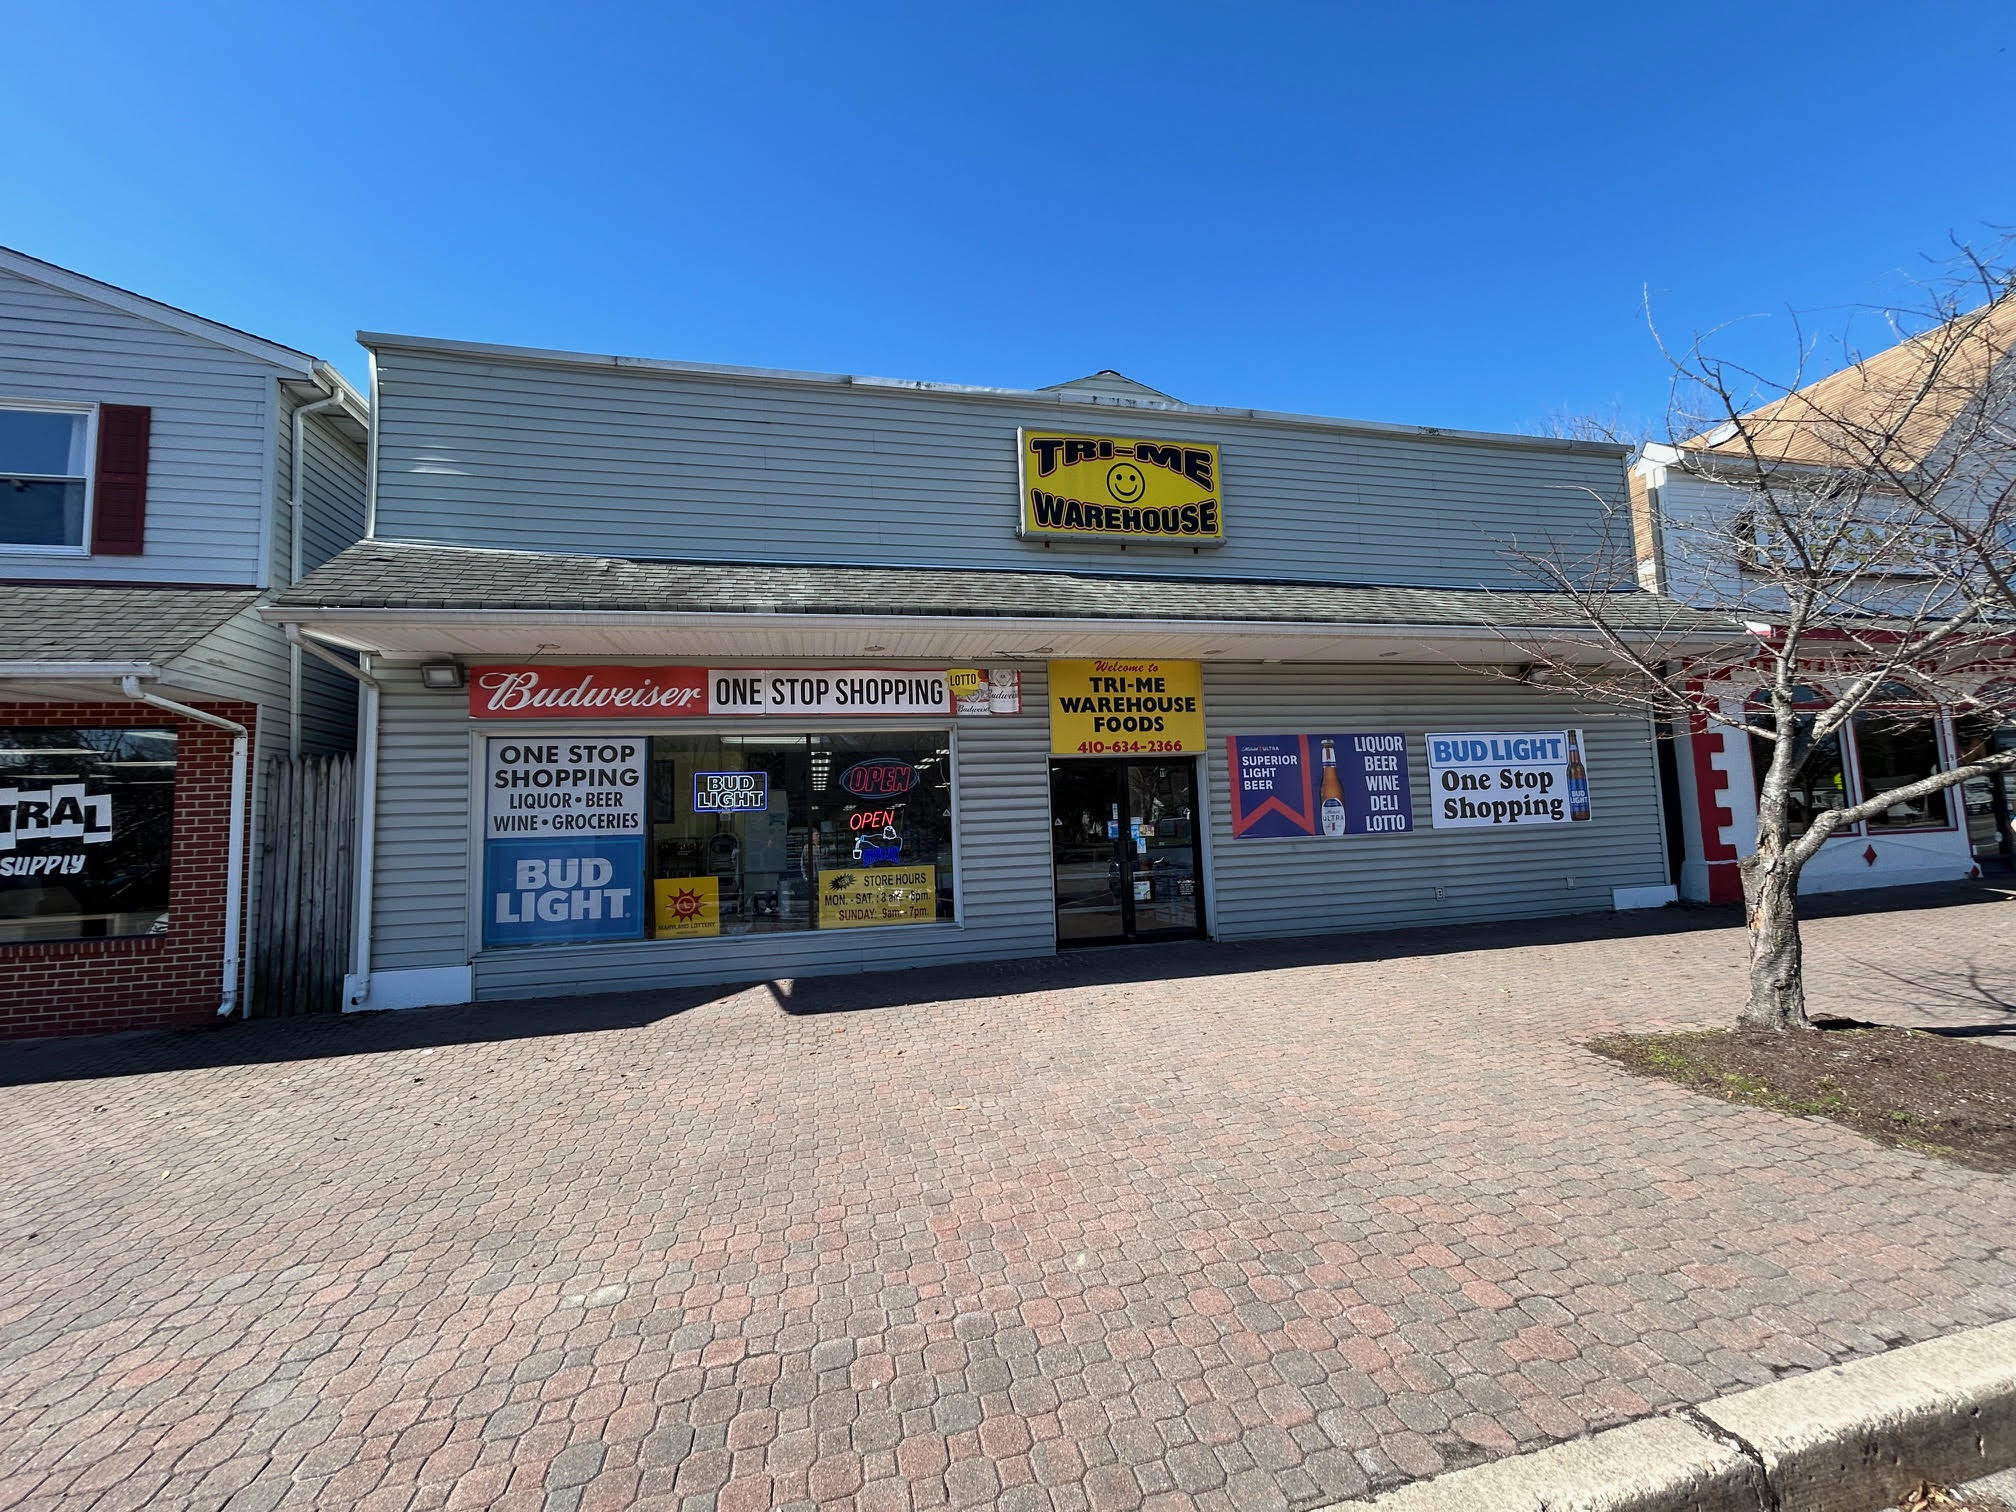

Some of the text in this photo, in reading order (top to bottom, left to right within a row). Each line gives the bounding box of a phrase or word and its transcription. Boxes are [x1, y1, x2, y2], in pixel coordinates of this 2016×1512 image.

[1030, 438, 1214, 492] TRI-ME
[1030, 488, 1218, 534] WAREHOUSE
[1095, 661, 1159, 673] Welcome to
[950, 674, 976, 686] LOTTO
[1089, 677, 1165, 693] TRI-ME
[479, 672, 701, 710] Budweiser
[716, 678, 943, 706] ONE STOP SHOPPING
[1059, 697, 1196, 713] WAREHOUSE
[1094, 716, 1164, 733] FOODS
[1077, 740, 1183, 753] 410-634-2366
[1354, 736, 1404, 753] LIQUOR
[1433, 738, 1562, 762] BUD LIGHT
[500, 745, 635, 764] ONE STOP
[1242, 755, 1298, 766] SUPERIOR
[1364, 756, 1398, 771] BEER
[494, 768, 639, 788] SHOPPING
[850, 766, 911, 792] OPEN
[1243, 768, 1276, 778] LIGHT
[1441, 768, 1553, 793] One Stop
[707, 775, 754, 791] BUD
[1244, 780, 1273, 790] BEER
[1366, 775, 1400, 791] WINE
[509, 792, 623, 810] LIQUOR BEER
[697, 790, 763, 808] LIGHT
[1371, 795, 1398, 811] DELI
[0, 796, 111, 834] TRAL
[1444, 794, 1565, 823] Shopping
[493, 813, 639, 831] WINE GROCERIES
[850, 810, 894, 830] OPEN
[1366, 814, 1406, 831] LOTTO
[0, 855, 86, 876] SUPPLY
[516, 858, 613, 890] BUD
[864, 873, 926, 887] STORE HOURS
[495, 888, 631, 923] LIGHT
